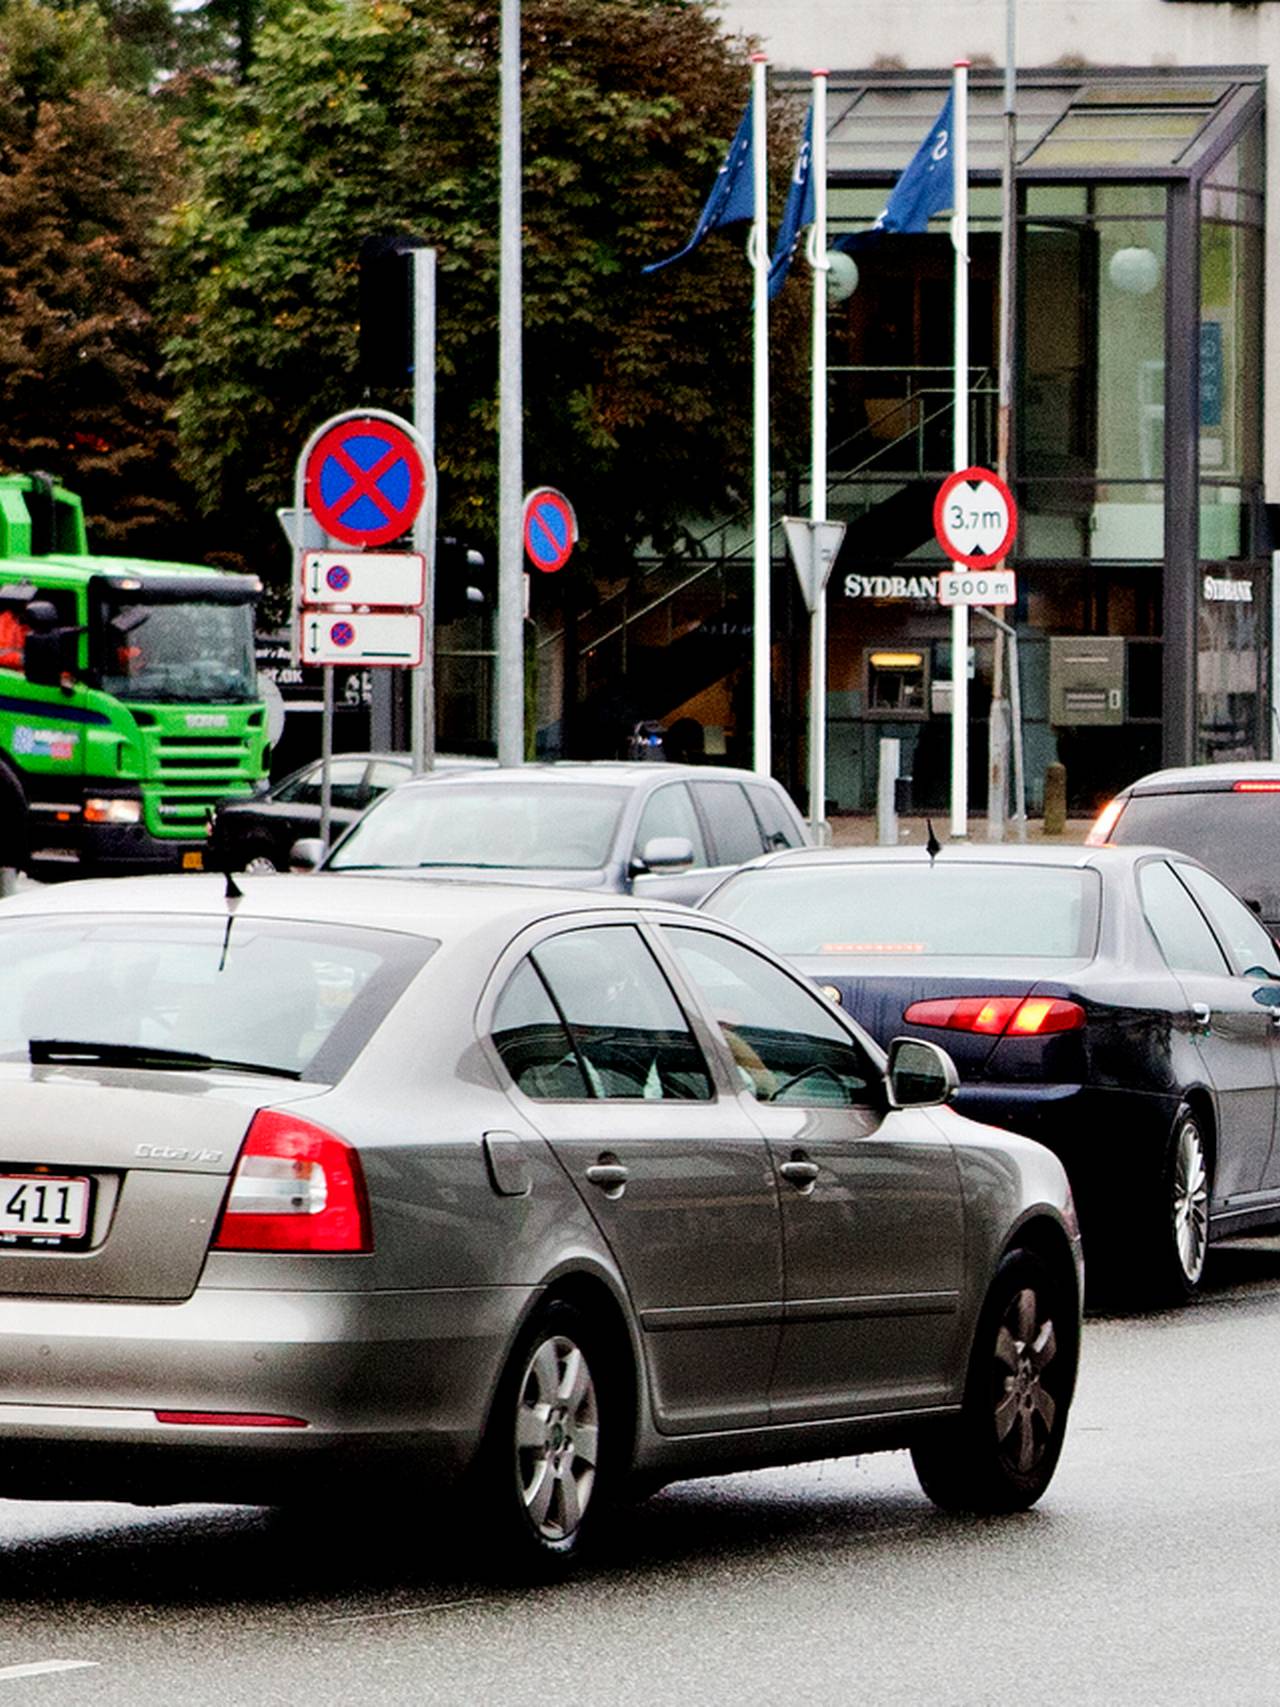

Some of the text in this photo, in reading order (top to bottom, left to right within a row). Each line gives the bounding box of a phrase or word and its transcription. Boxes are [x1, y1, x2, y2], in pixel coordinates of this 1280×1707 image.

[844, 573, 939, 598] SYDBAN
[948, 580, 1010, 597] 500 m
[6, 1183, 71, 1225] 411
